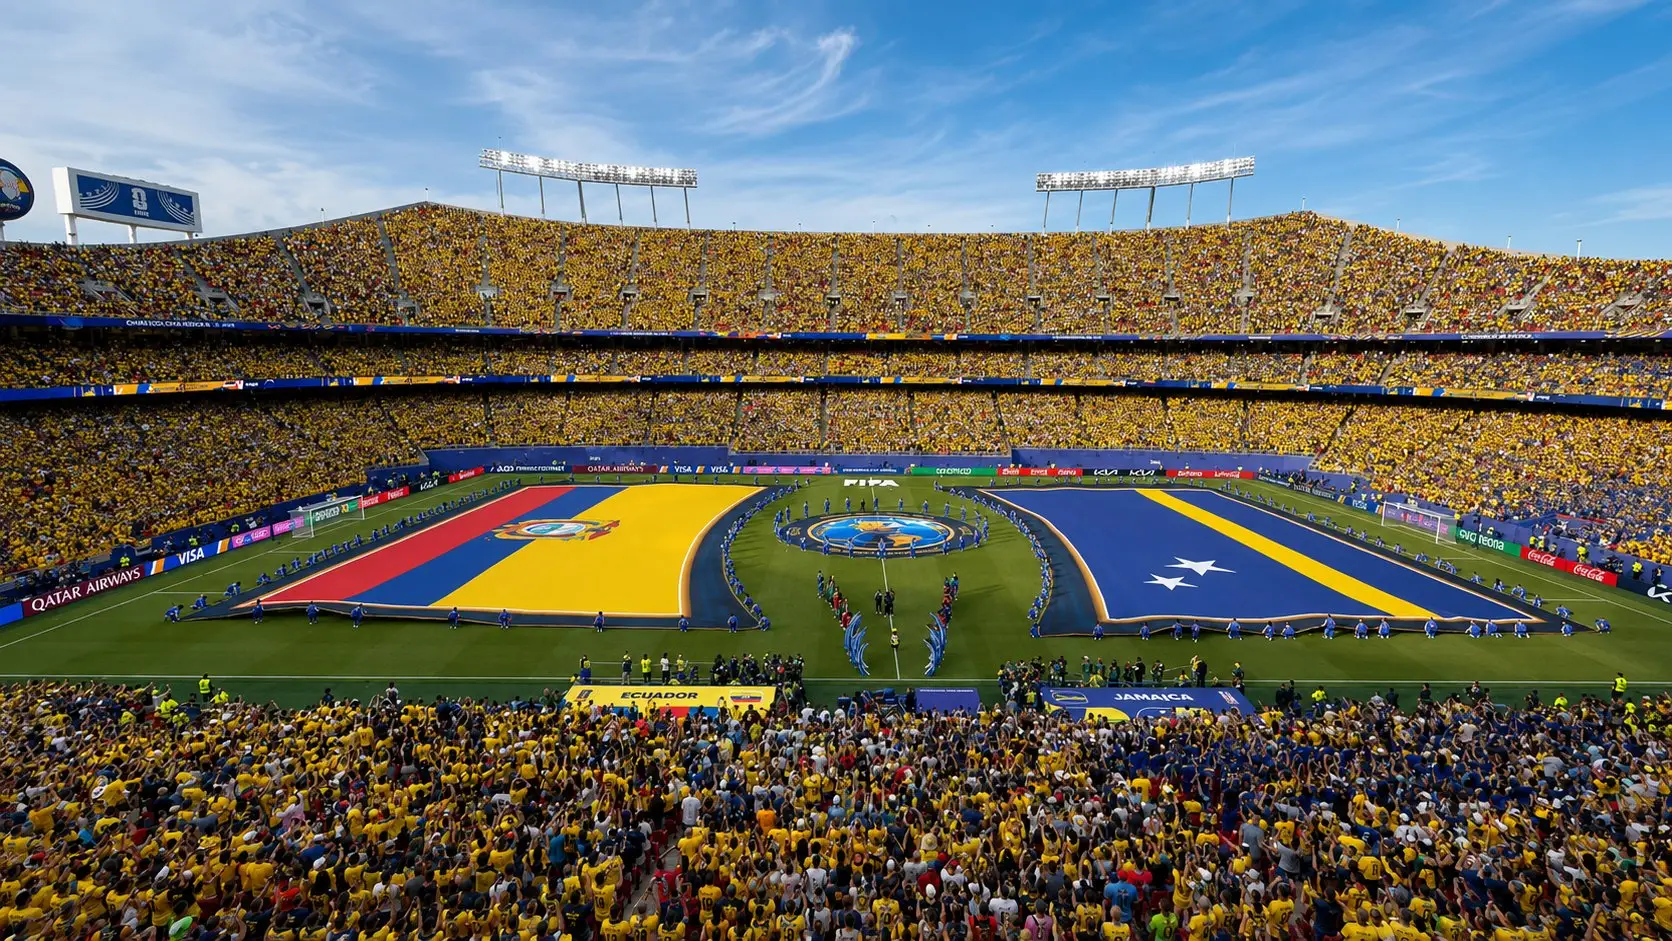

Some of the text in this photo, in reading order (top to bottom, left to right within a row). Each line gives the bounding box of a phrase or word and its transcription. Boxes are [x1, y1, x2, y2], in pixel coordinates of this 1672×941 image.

[178, 546, 205, 565] VISA
[31, 567, 141, 612] QATAR AIRWAYS
[620, 691, 699, 700] ECUADOR
[1113, 693, 1195, 702] JAMAICA
